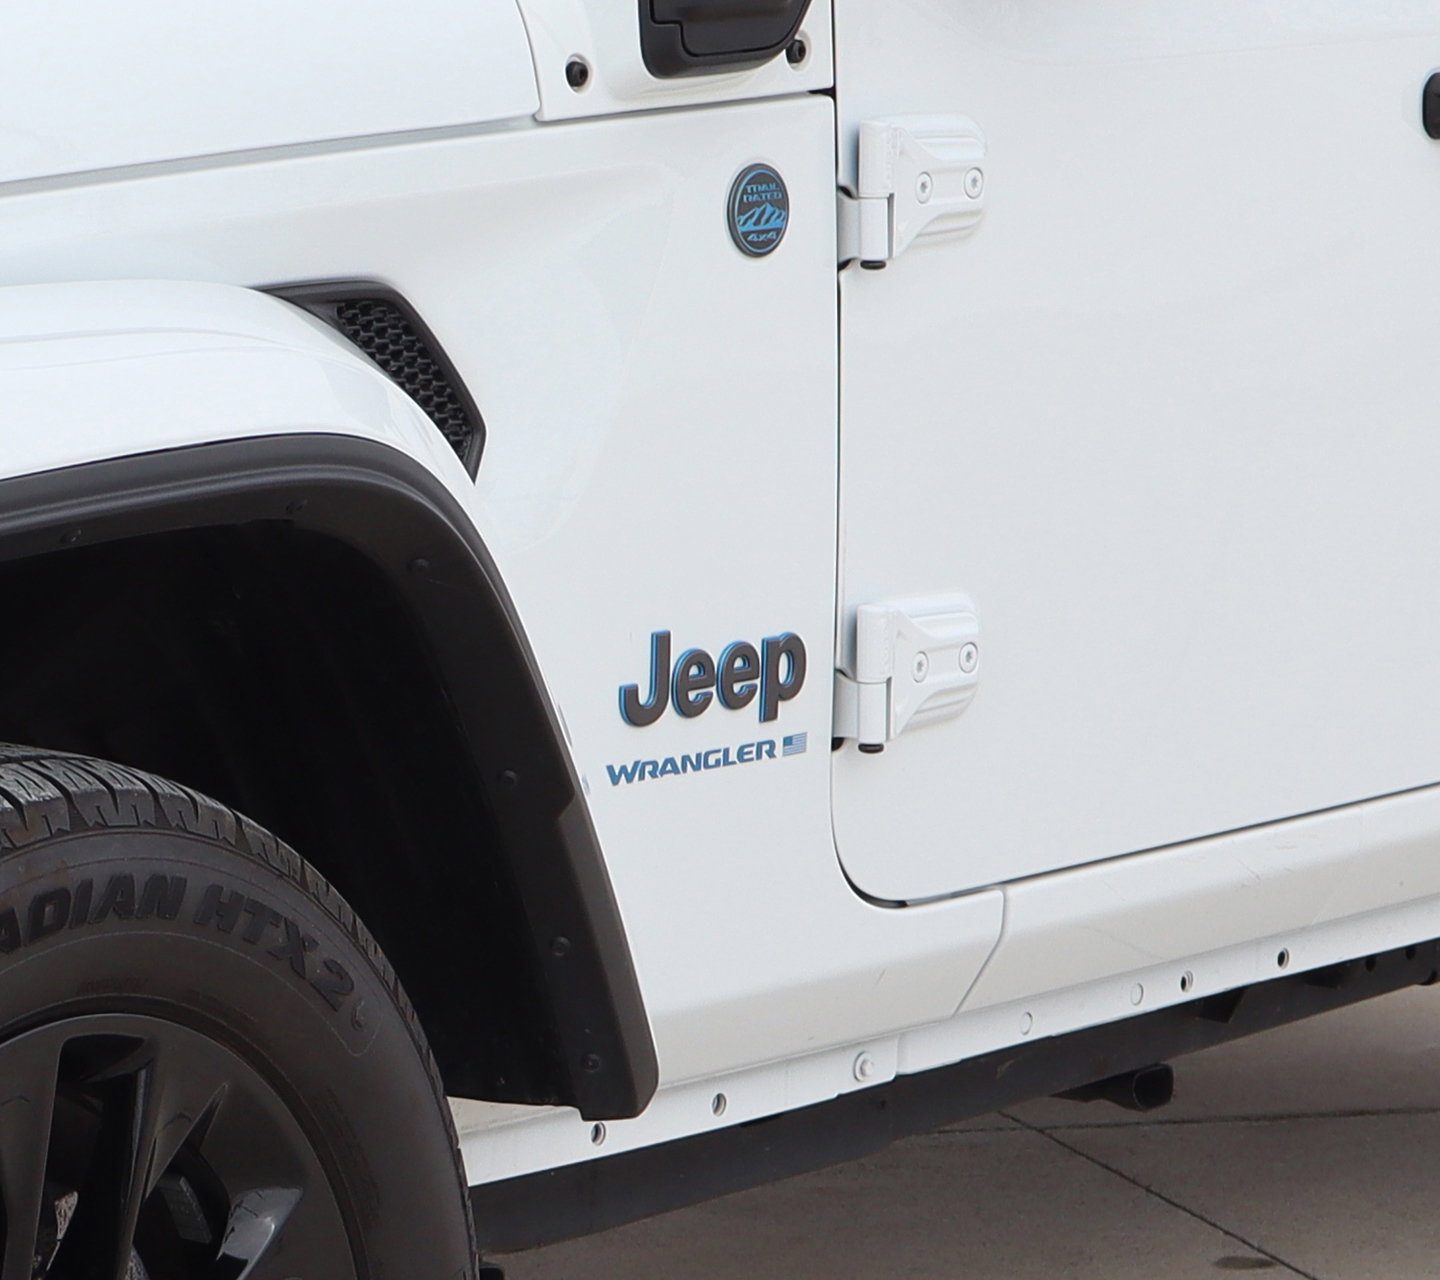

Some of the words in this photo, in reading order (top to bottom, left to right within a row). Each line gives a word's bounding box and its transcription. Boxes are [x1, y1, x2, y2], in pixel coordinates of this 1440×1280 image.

[742, 191, 782, 203] RATED
[618, 629, 808, 728] Jeep
[606, 739, 777, 787] WRANGLER
